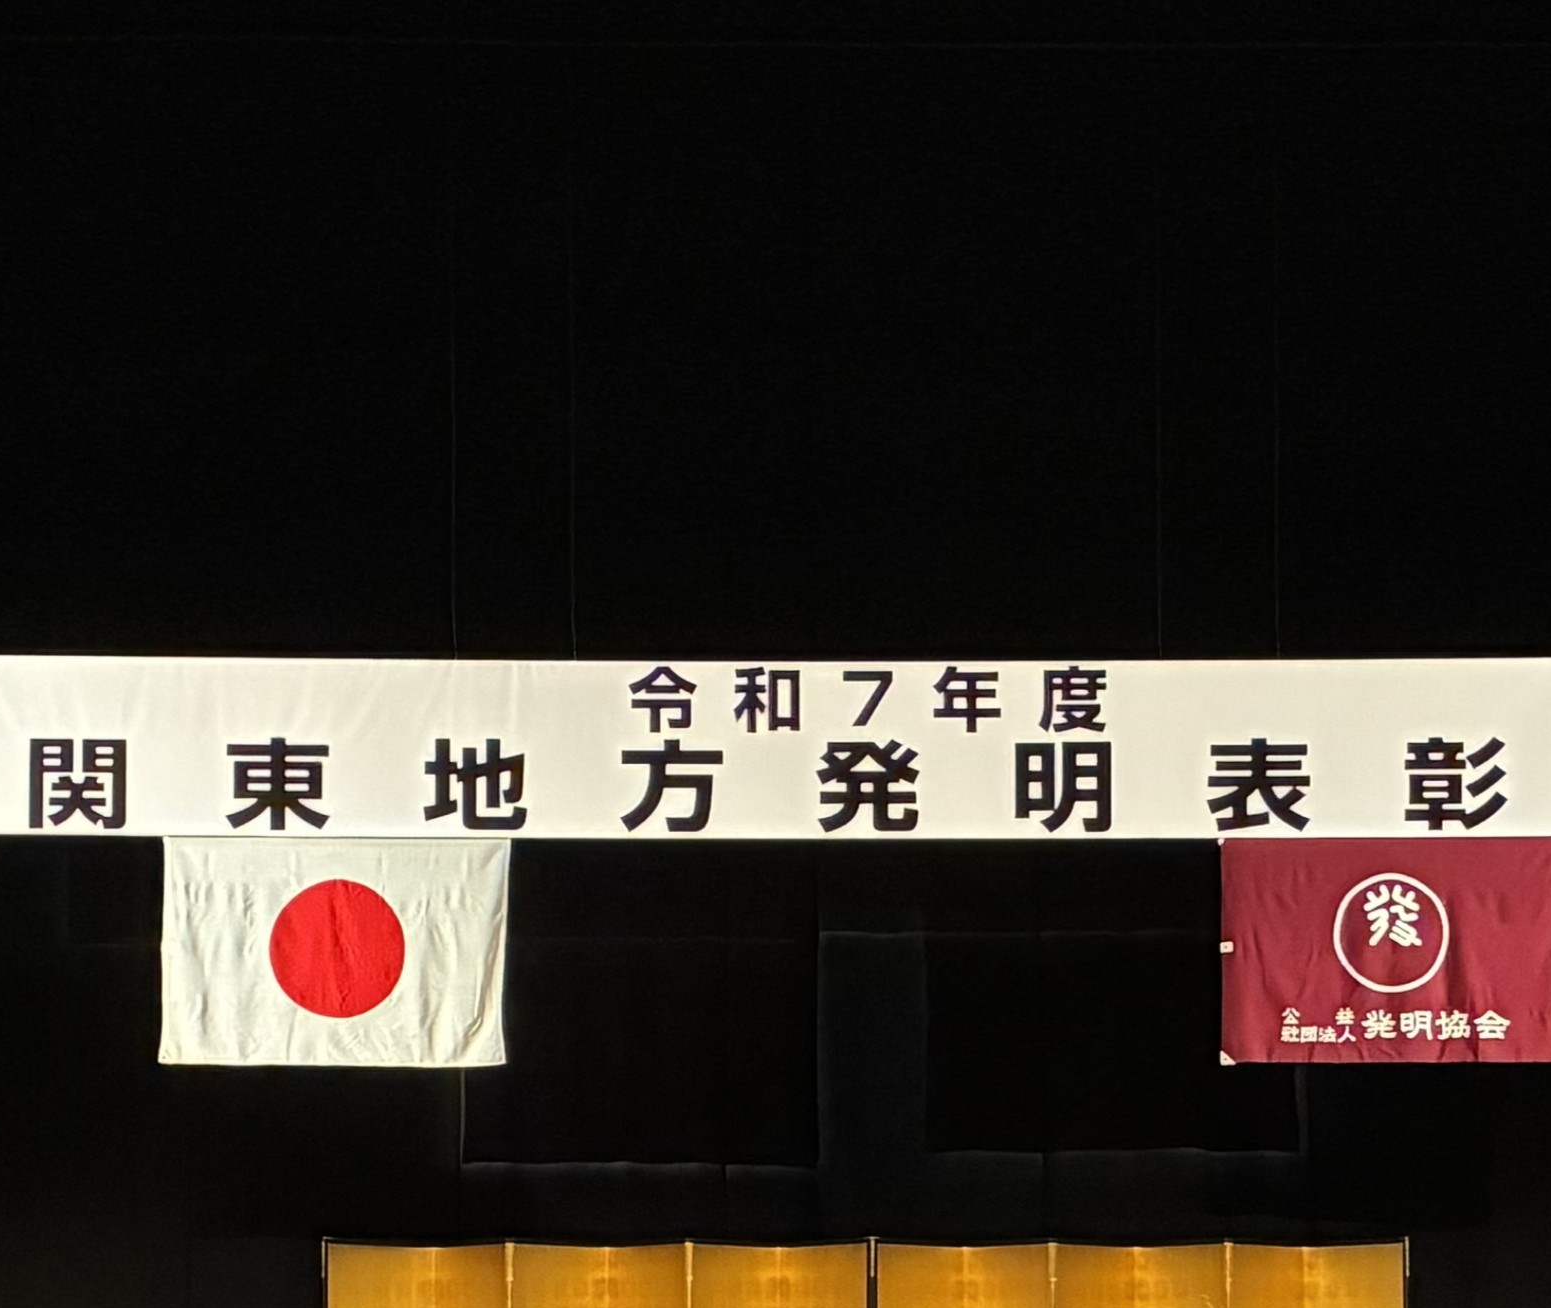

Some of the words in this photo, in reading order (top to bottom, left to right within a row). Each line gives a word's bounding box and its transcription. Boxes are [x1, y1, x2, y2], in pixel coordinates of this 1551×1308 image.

[628, 665, 1108, 734] 令和7年度
[1360, 1009, 1512, 1041] 発明協会
